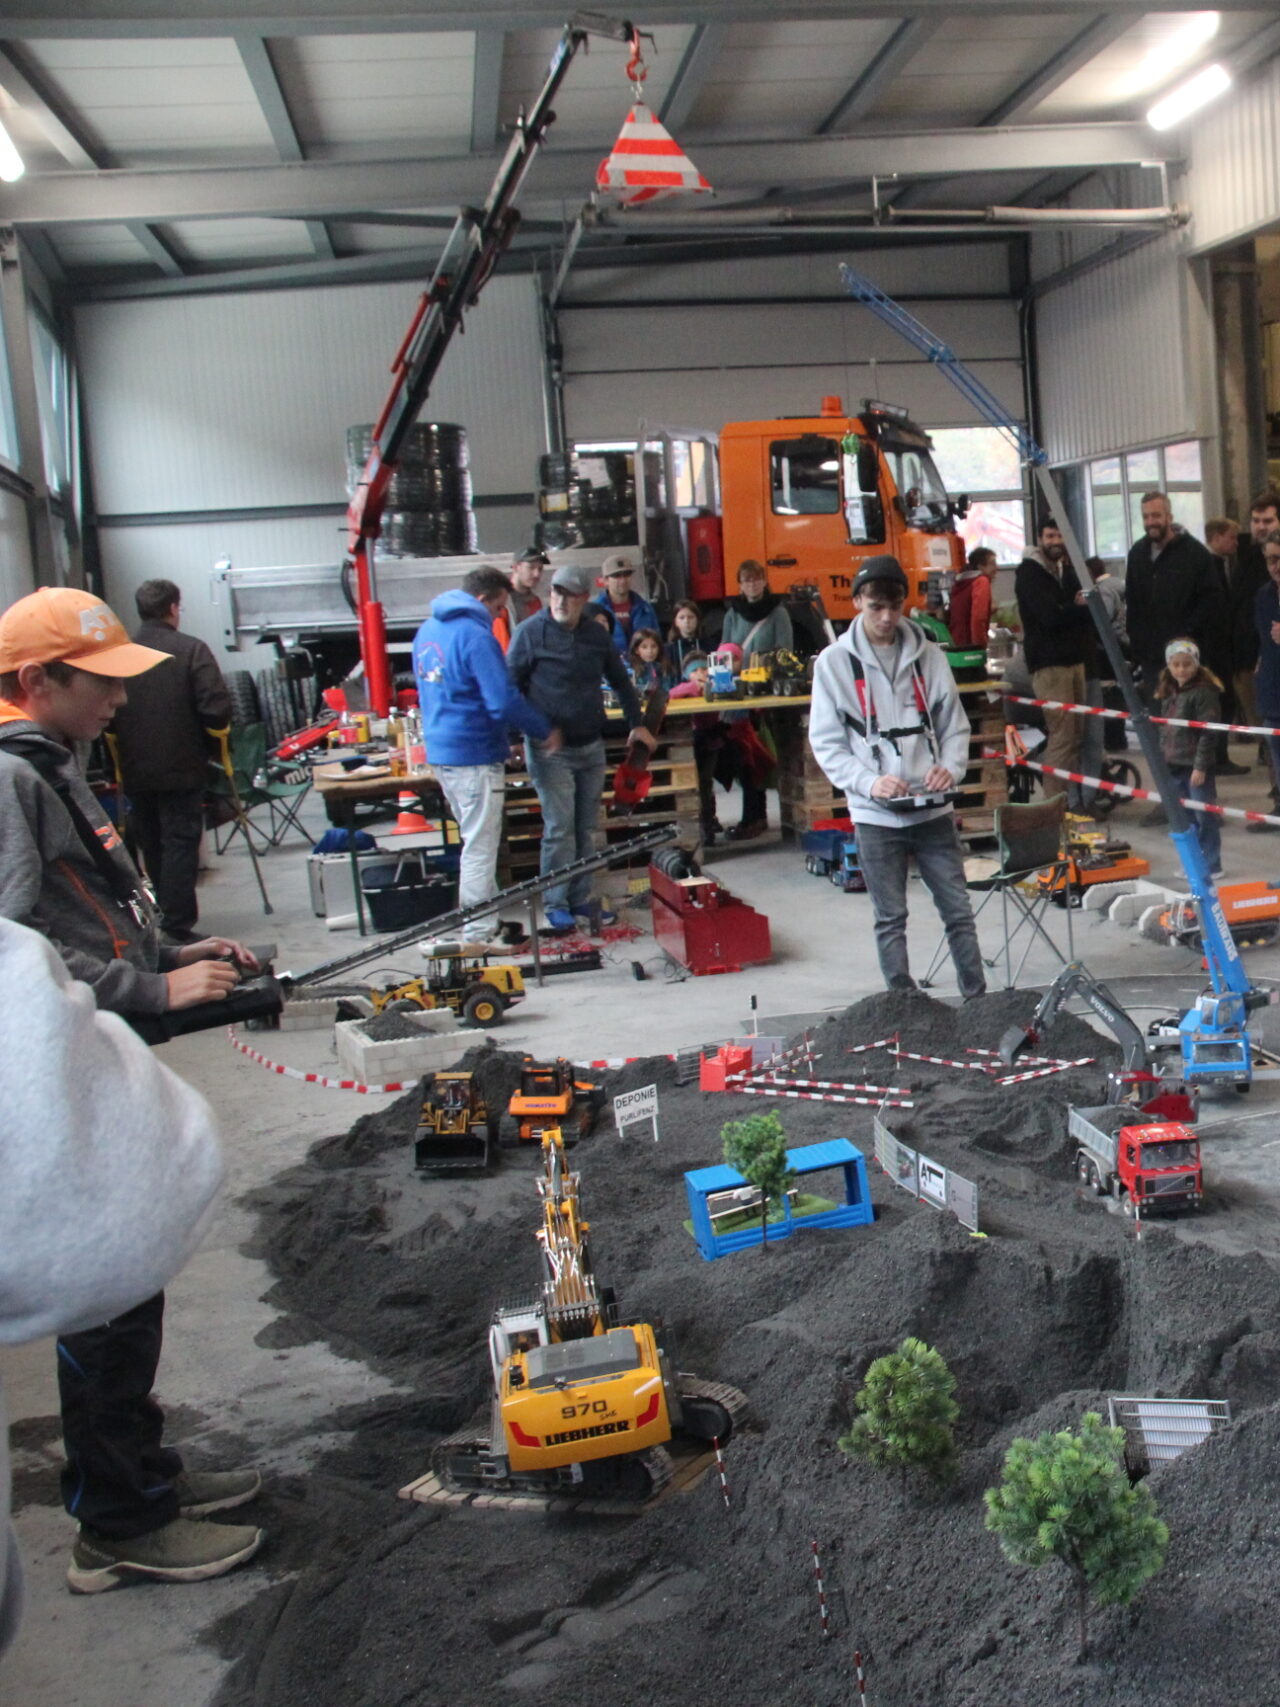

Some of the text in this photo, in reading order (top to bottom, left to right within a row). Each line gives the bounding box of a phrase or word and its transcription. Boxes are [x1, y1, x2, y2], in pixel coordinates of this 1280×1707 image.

[1091, 995, 1115, 1022] VOLVO
[616, 1086, 656, 1110] DEPONIE
[561, 1400, 607, 1419] 970
[545, 1420, 631, 1446] LIEBHERR
